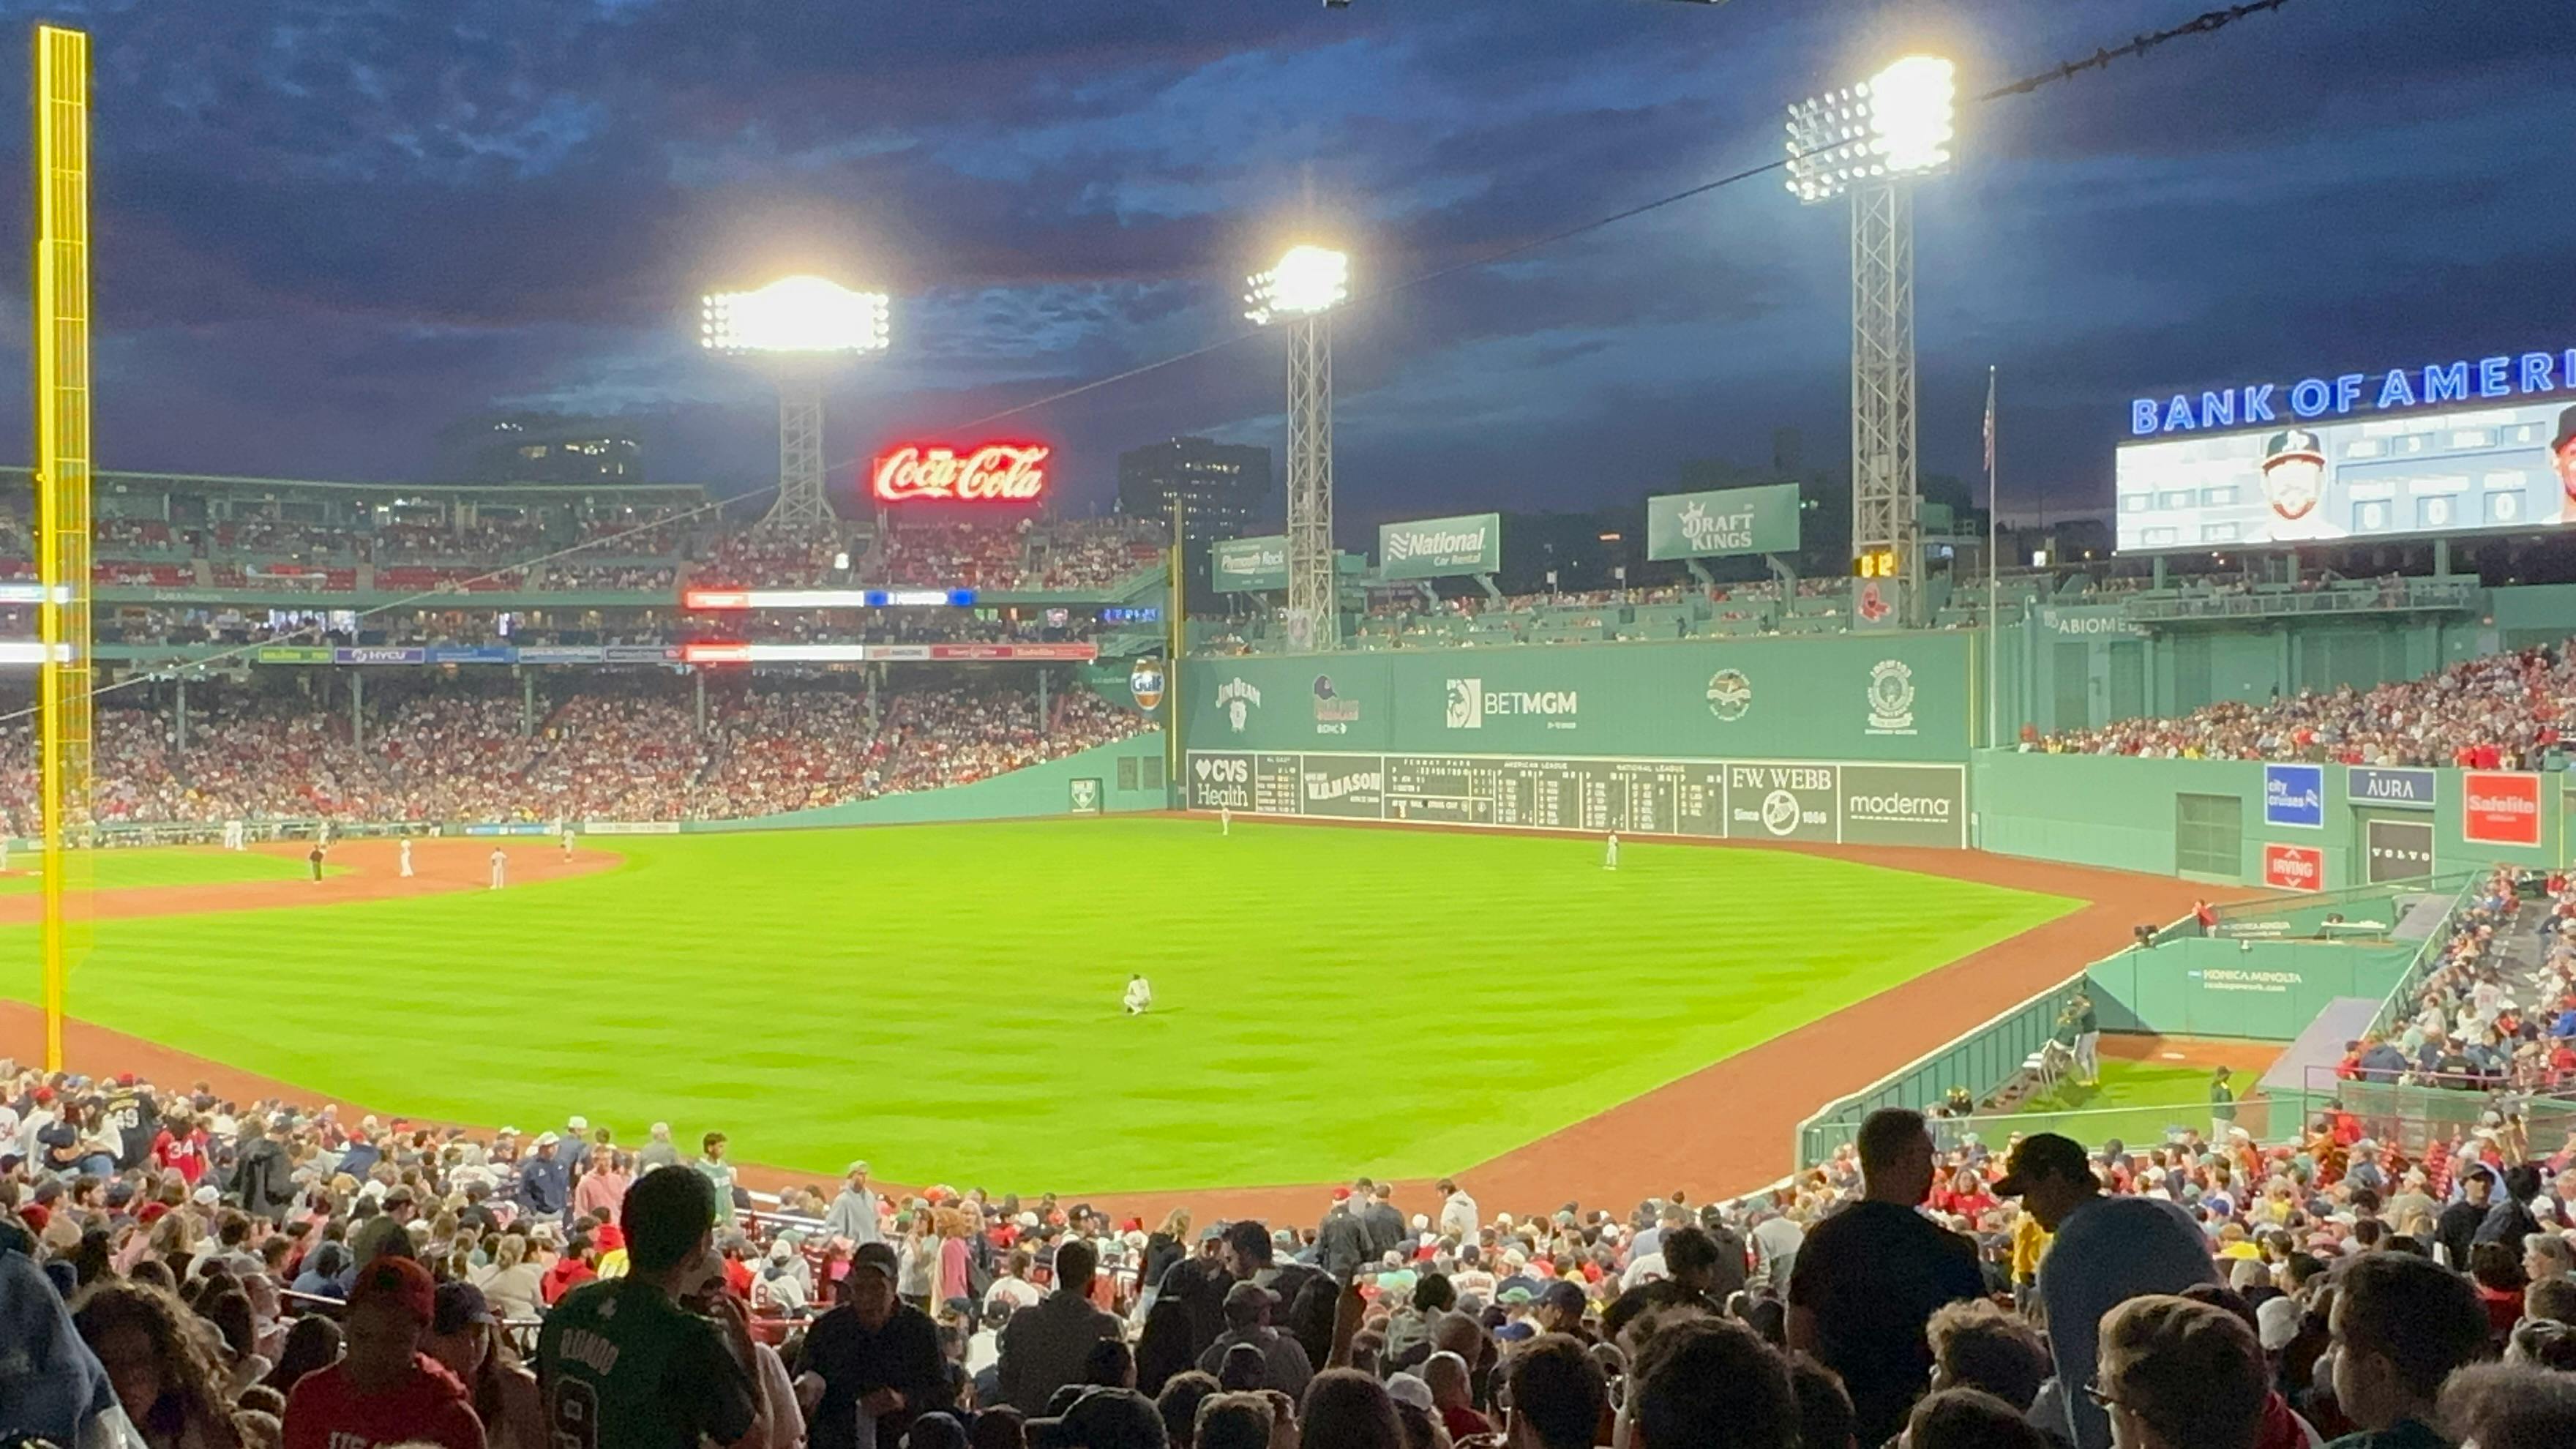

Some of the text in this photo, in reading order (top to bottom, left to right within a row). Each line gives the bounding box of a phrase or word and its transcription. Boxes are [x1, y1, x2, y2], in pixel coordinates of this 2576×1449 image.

[2132, 384, 2275, 435] BANK
[2291, 373, 2363, 416] OF
[877, 446, 1049, 500] Coca-Cola
[1682, 514, 1754, 538] DRAFT
[1408, 527, 1486, 556] National
[1692, 532, 1752, 551] KINGS
[1434, 556, 1450, 567] Car
[1484, 691, 1577, 714] BETMGM
[1213, 759, 1248, 783] CVS
[1770, 768, 1832, 790] WEBB
[1197, 782, 1248, 807] Health
[2269, 779, 2288, 796] city
[1850, 792, 1950, 815] moderna
[2269, 795, 2304, 808] cruises
[2468, 795, 2534, 814] Safelite
[2372, 847, 2430, 861] VOLVO
[2273, 858, 2313, 877] IRVING
[2203, 969, 2302, 984] KONICA MINOLTA
[168, 1139, 193, 1159] 34
